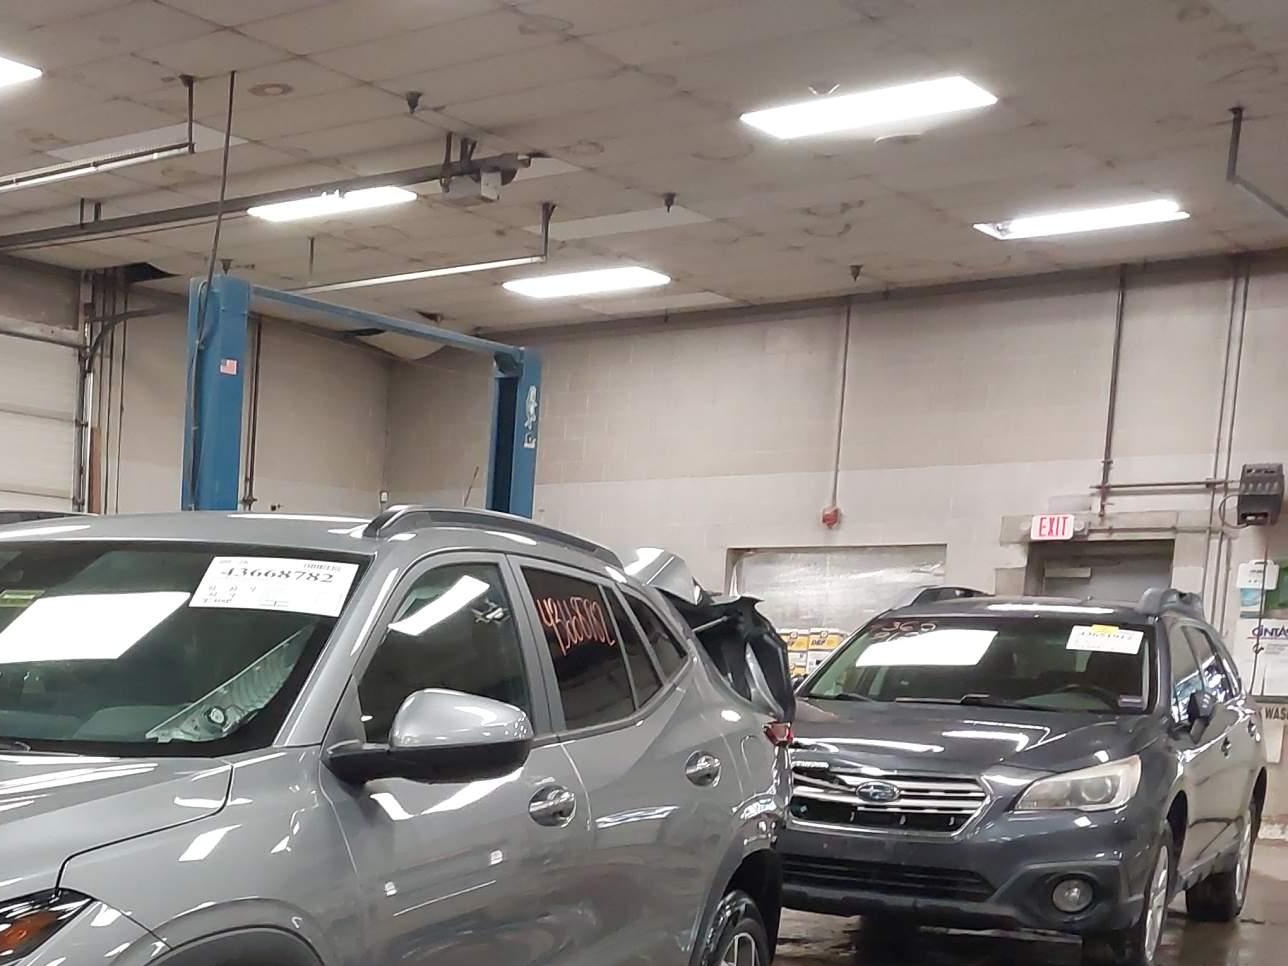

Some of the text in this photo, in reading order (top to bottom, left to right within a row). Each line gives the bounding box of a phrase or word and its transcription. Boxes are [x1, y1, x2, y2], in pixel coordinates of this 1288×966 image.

[1038, 516, 1069, 537] EXIT
[220, 567, 334, 584] 43668782
[1251, 624, 1288, 638] CINTA
[1264, 706, 1288, 721] WAS
